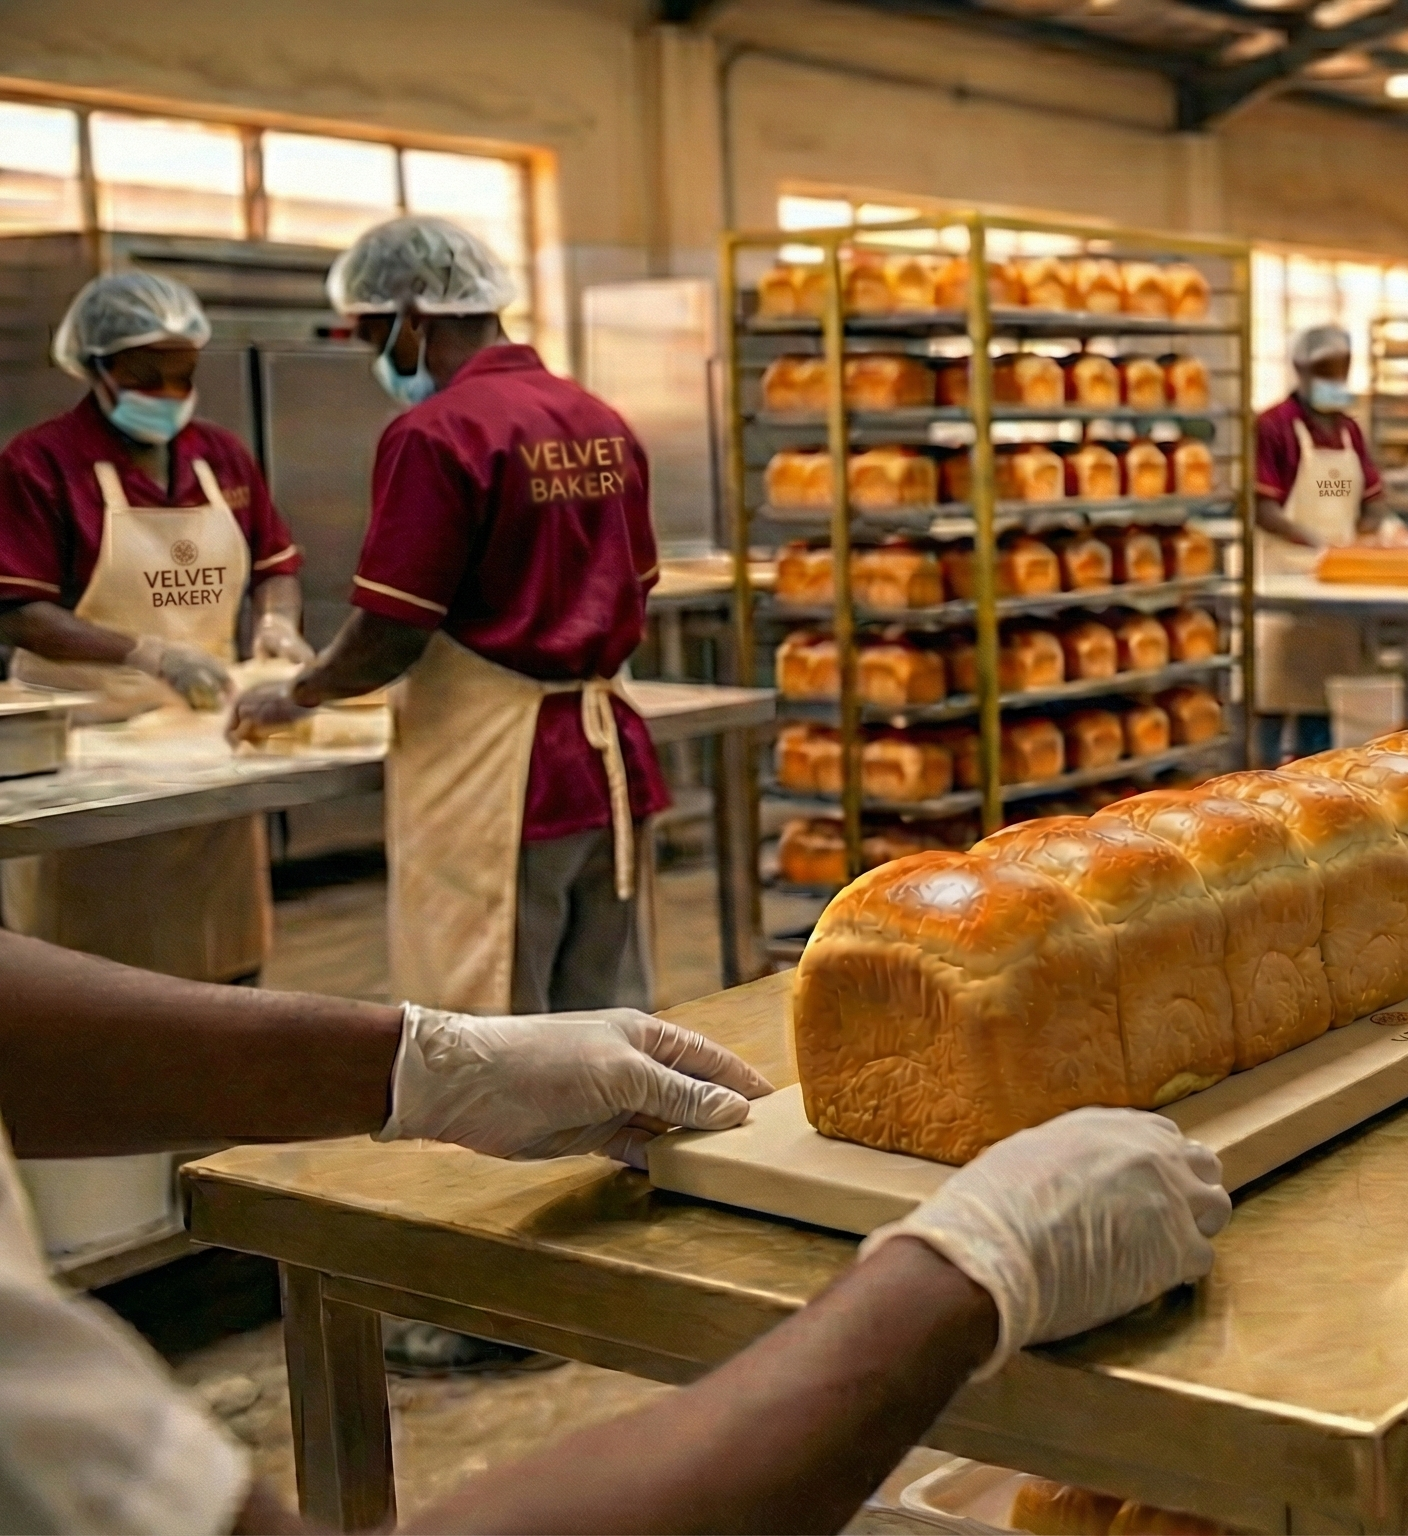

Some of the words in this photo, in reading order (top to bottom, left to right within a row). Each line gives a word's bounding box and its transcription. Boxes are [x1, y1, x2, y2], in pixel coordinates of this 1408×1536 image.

[520, 437, 625, 471] VELVET
[531, 470, 629, 502] BAKERY
[143, 566, 227, 589] VELVET
[152, 589, 223, 608] BAKERY
